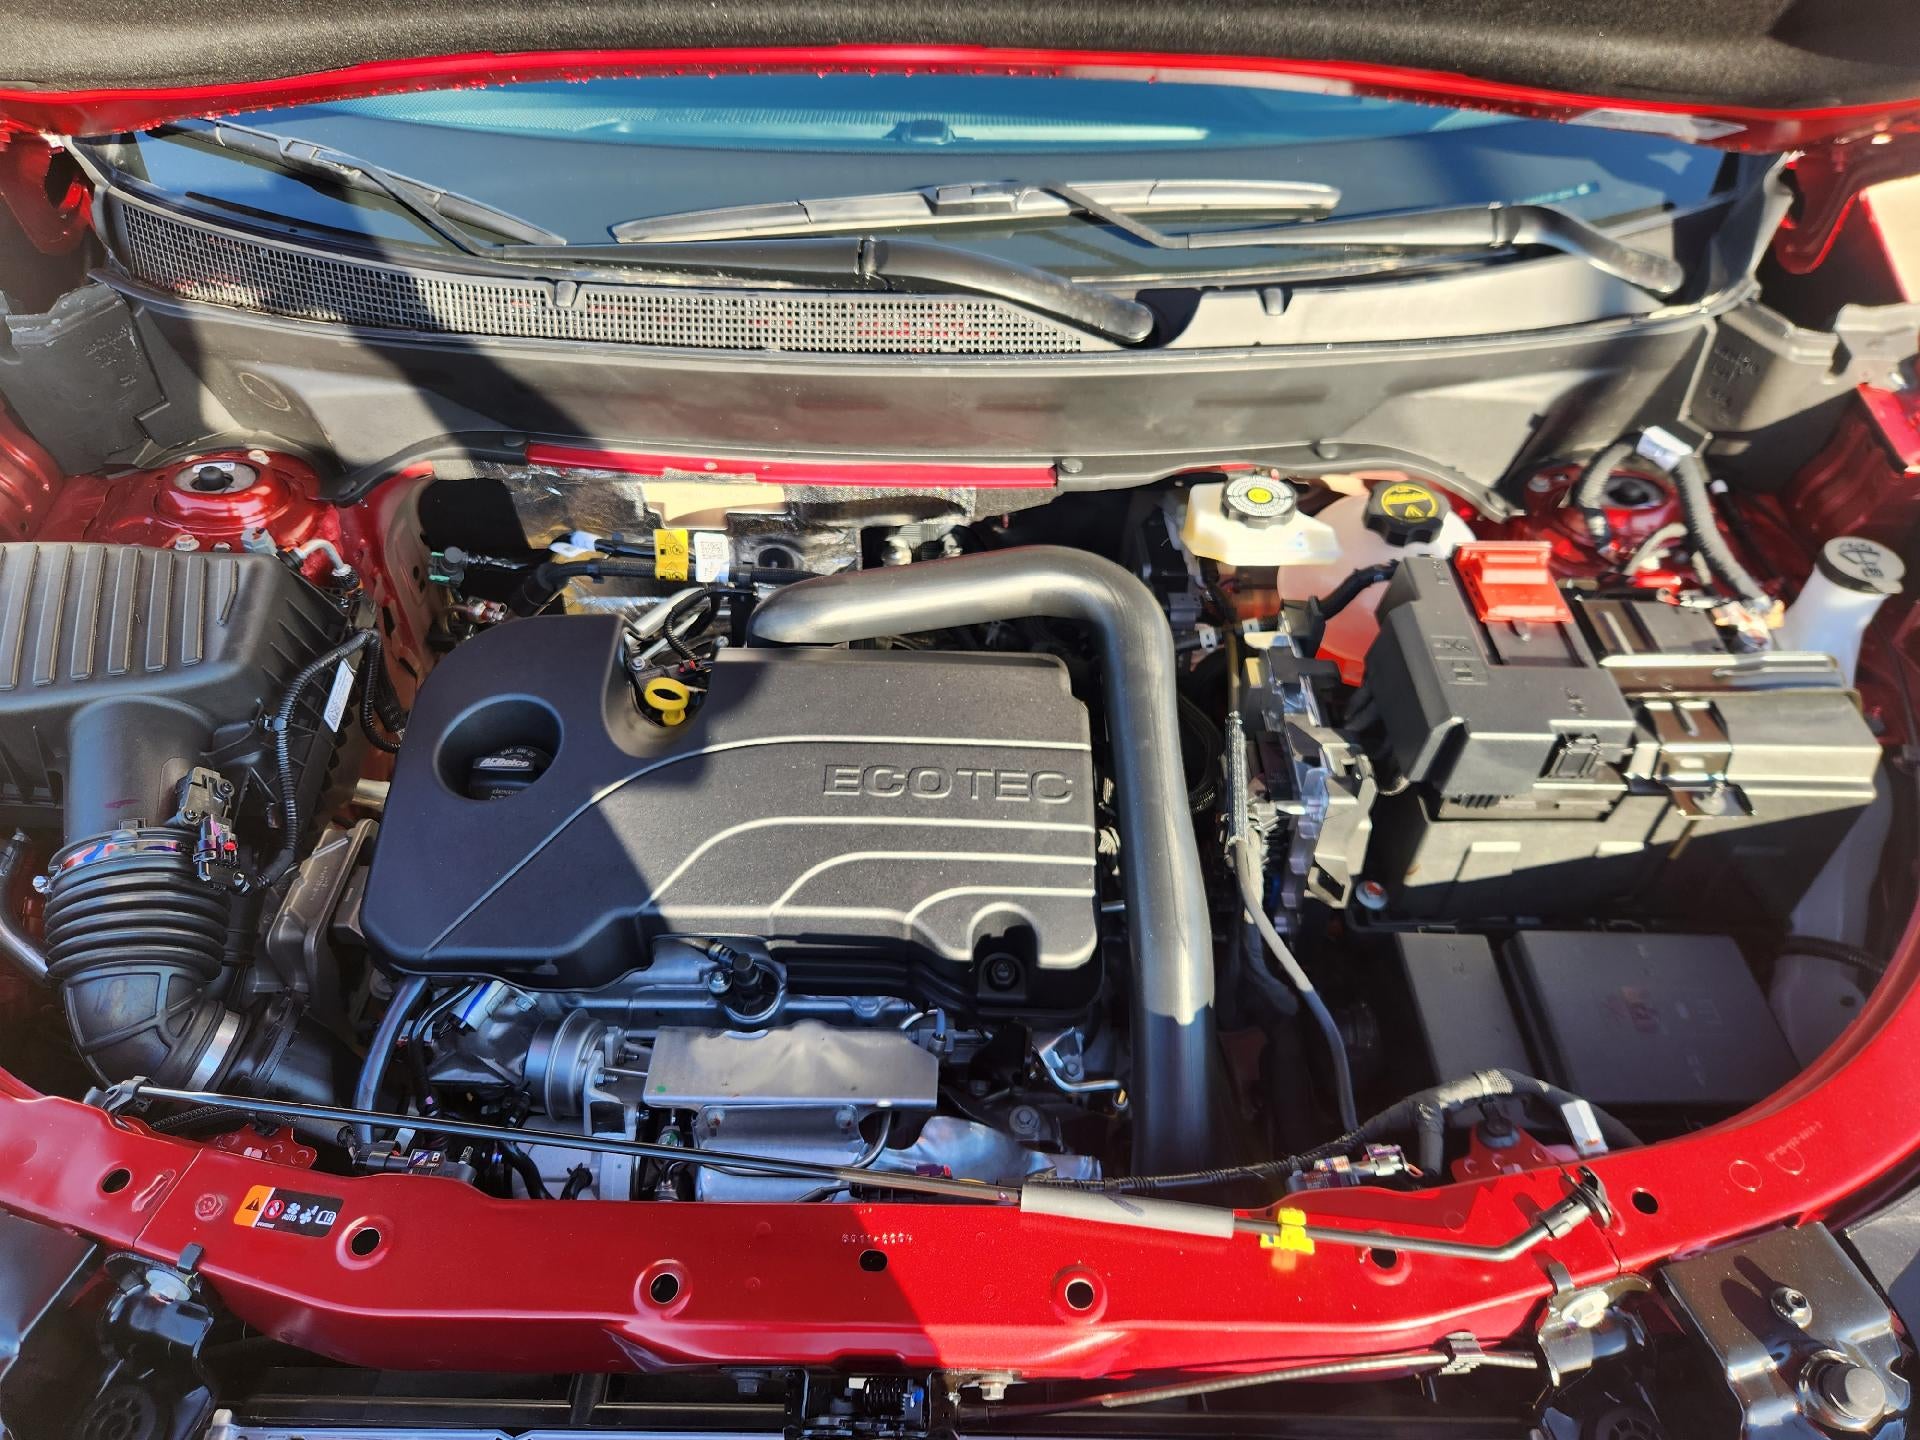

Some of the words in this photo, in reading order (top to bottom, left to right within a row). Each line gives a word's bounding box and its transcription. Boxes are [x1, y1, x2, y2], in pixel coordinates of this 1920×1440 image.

[479, 757, 530, 768] ACDelco
[823, 764, 1074, 804] ECOTEC
[281, 1213, 298, 1222] AUTO
